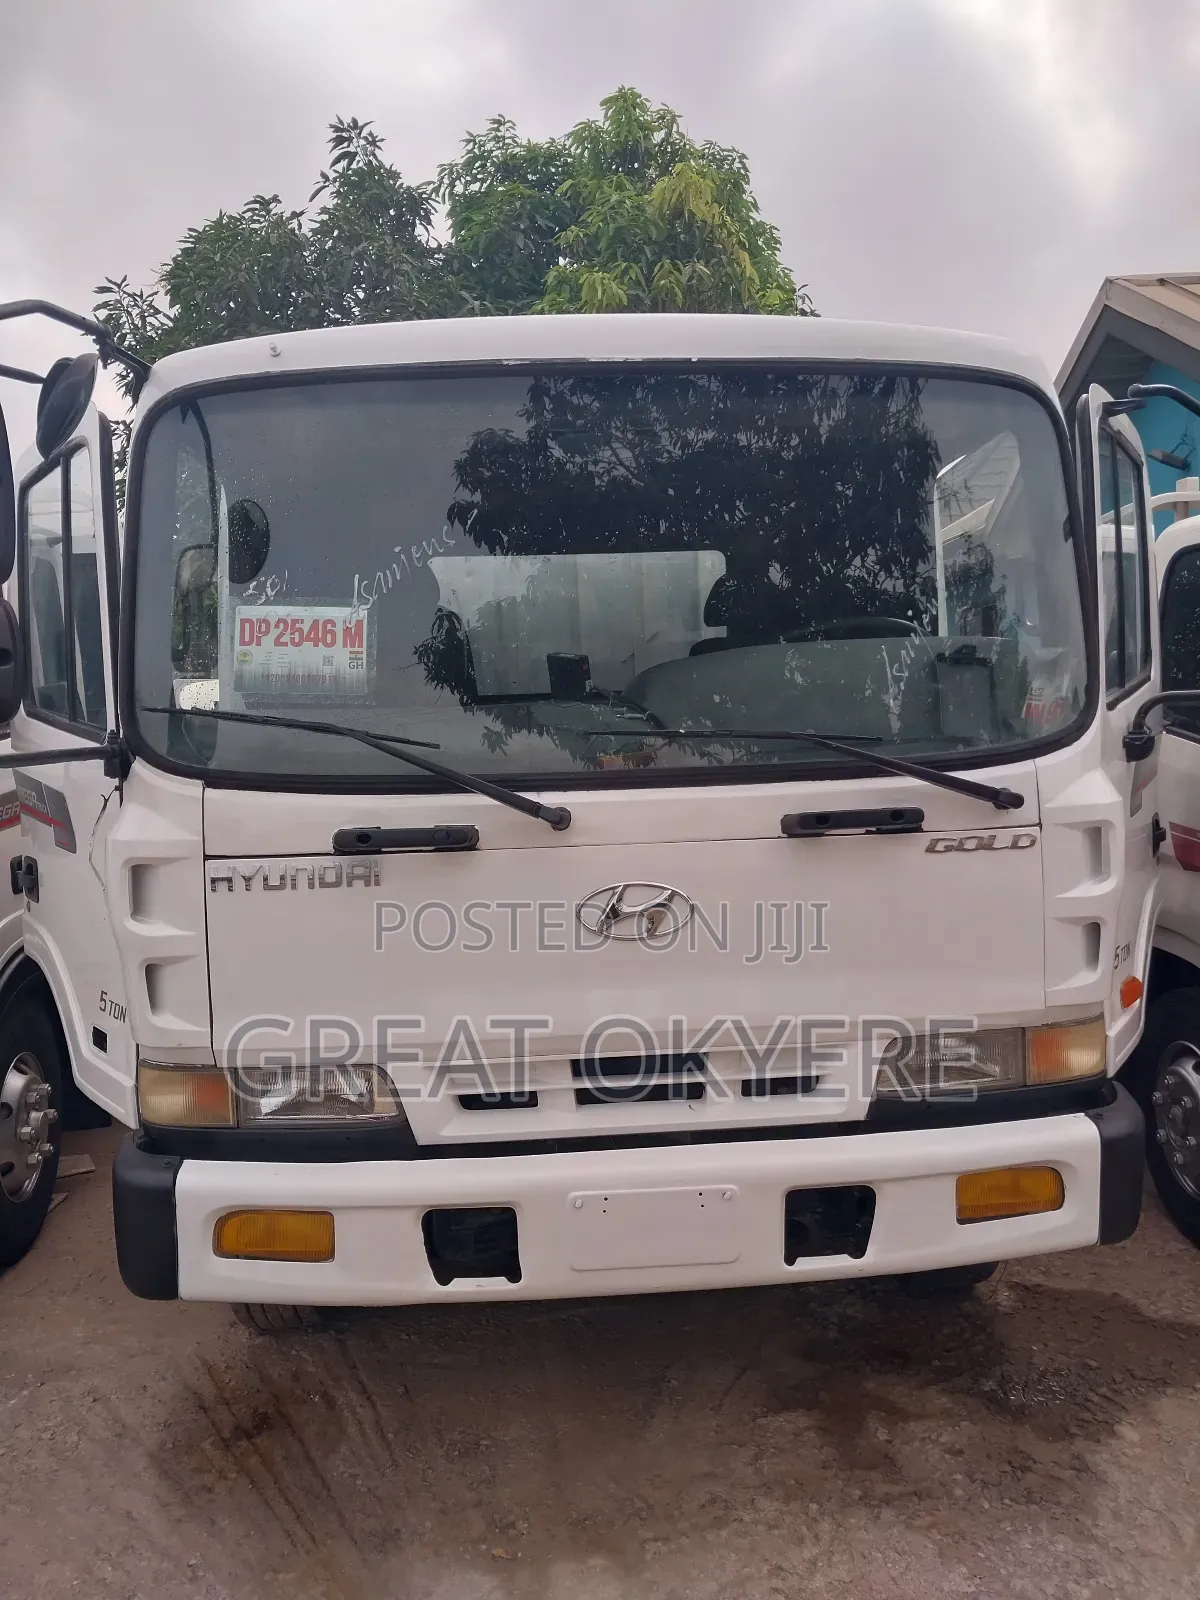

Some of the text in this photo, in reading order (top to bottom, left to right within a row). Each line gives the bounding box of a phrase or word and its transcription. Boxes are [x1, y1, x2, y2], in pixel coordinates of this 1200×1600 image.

[239, 618, 364, 649] DP 2546 M
[348, 661, 364, 670] GH
[924, 833, 1038, 853] GOLD
[209, 860, 381, 892] HYUNDAI
[1114, 944, 1120, 971] 5
[99, 990, 127, 1023] 5 TON
